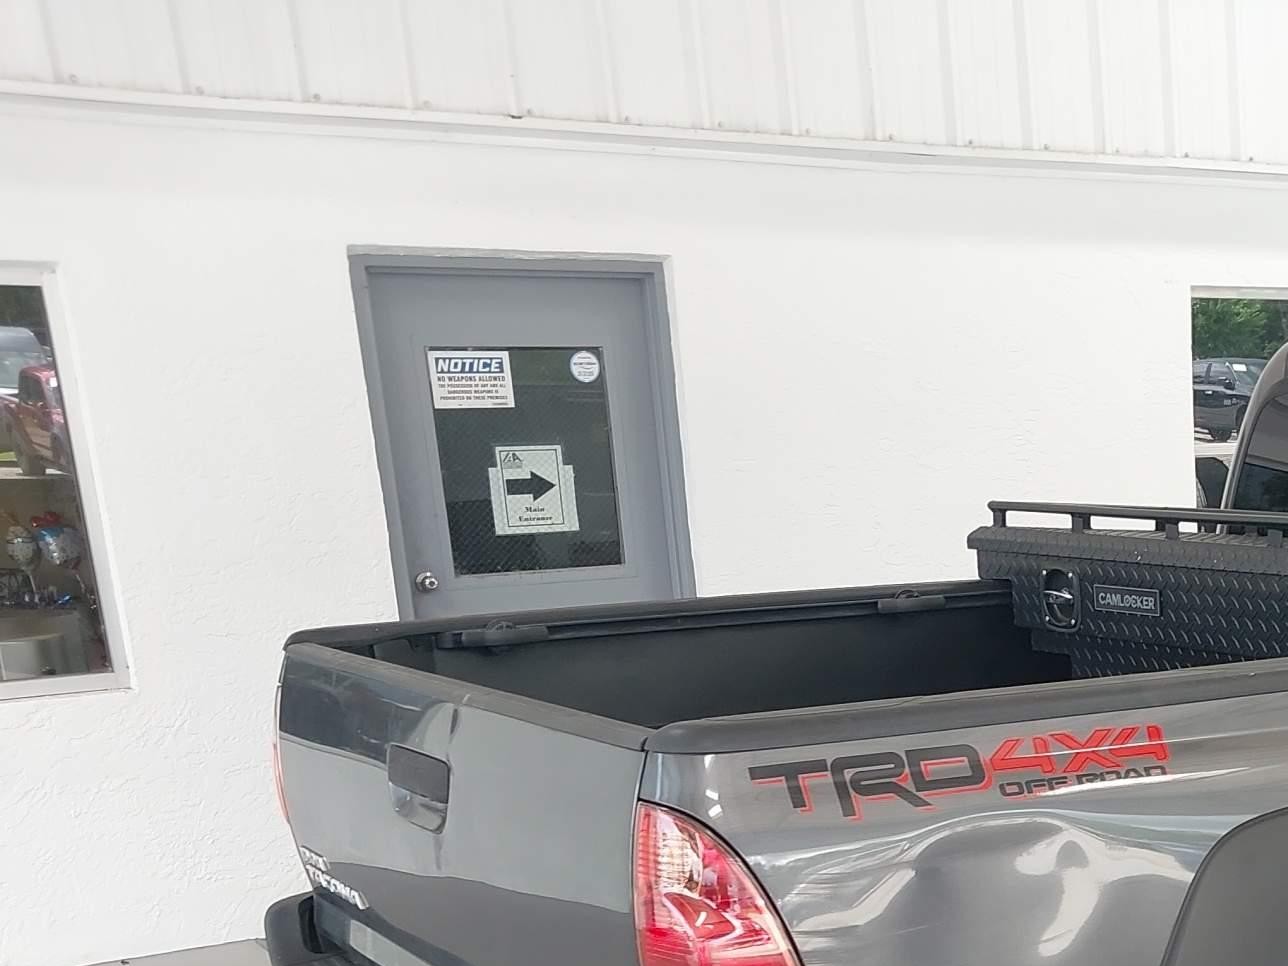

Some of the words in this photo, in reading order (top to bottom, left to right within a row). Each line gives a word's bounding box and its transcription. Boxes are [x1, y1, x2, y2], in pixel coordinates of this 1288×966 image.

[437, 358, 502, 372] NOTICE
[1098, 592, 1156, 610] CAMLOCKER
[748, 743, 991, 820] TRD
[999, 772, 1068, 798] OFF
